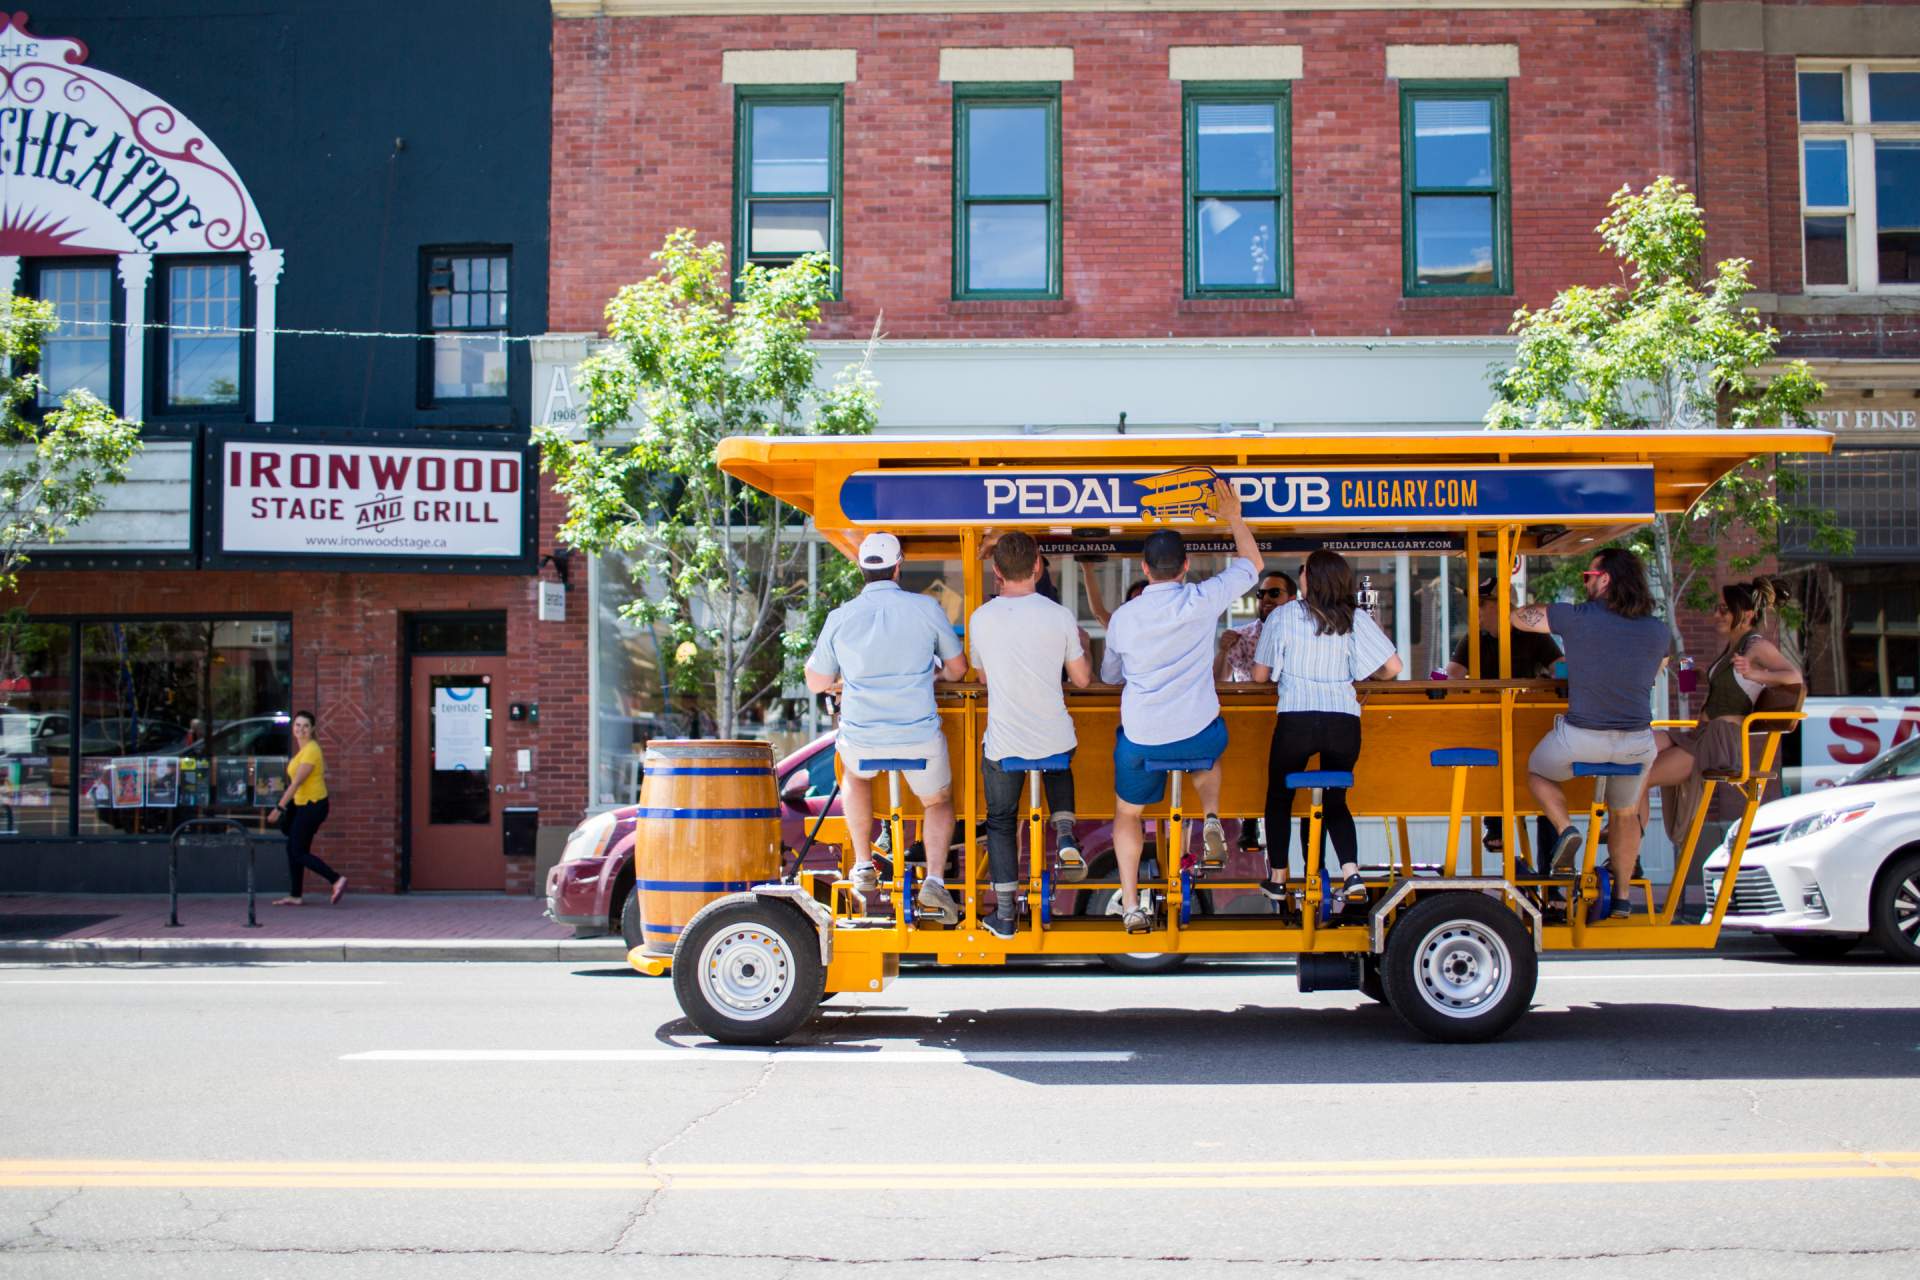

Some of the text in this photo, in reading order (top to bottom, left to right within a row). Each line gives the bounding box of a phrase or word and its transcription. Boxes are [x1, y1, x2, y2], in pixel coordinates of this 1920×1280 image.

[0, 43, 39, 57] HE
[552, 410, 577, 421] 1908
[1854, 410, 1916, 429] FINE
[230, 451, 519, 493] IRONWOOD
[984, 476, 1478, 514] PEDAL PUB CALGARY.COM
[251, 497, 499, 526] STAGE AND GRILL
[306, 534, 447, 549] www.ironwoodstage.ca
[1038, 543, 1117, 552] ALPUBCANADA
[1184, 542, 1273, 551] EDALHAPSS
[1322, 541, 1452, 549] PEDALPUBCALGARY.COM
